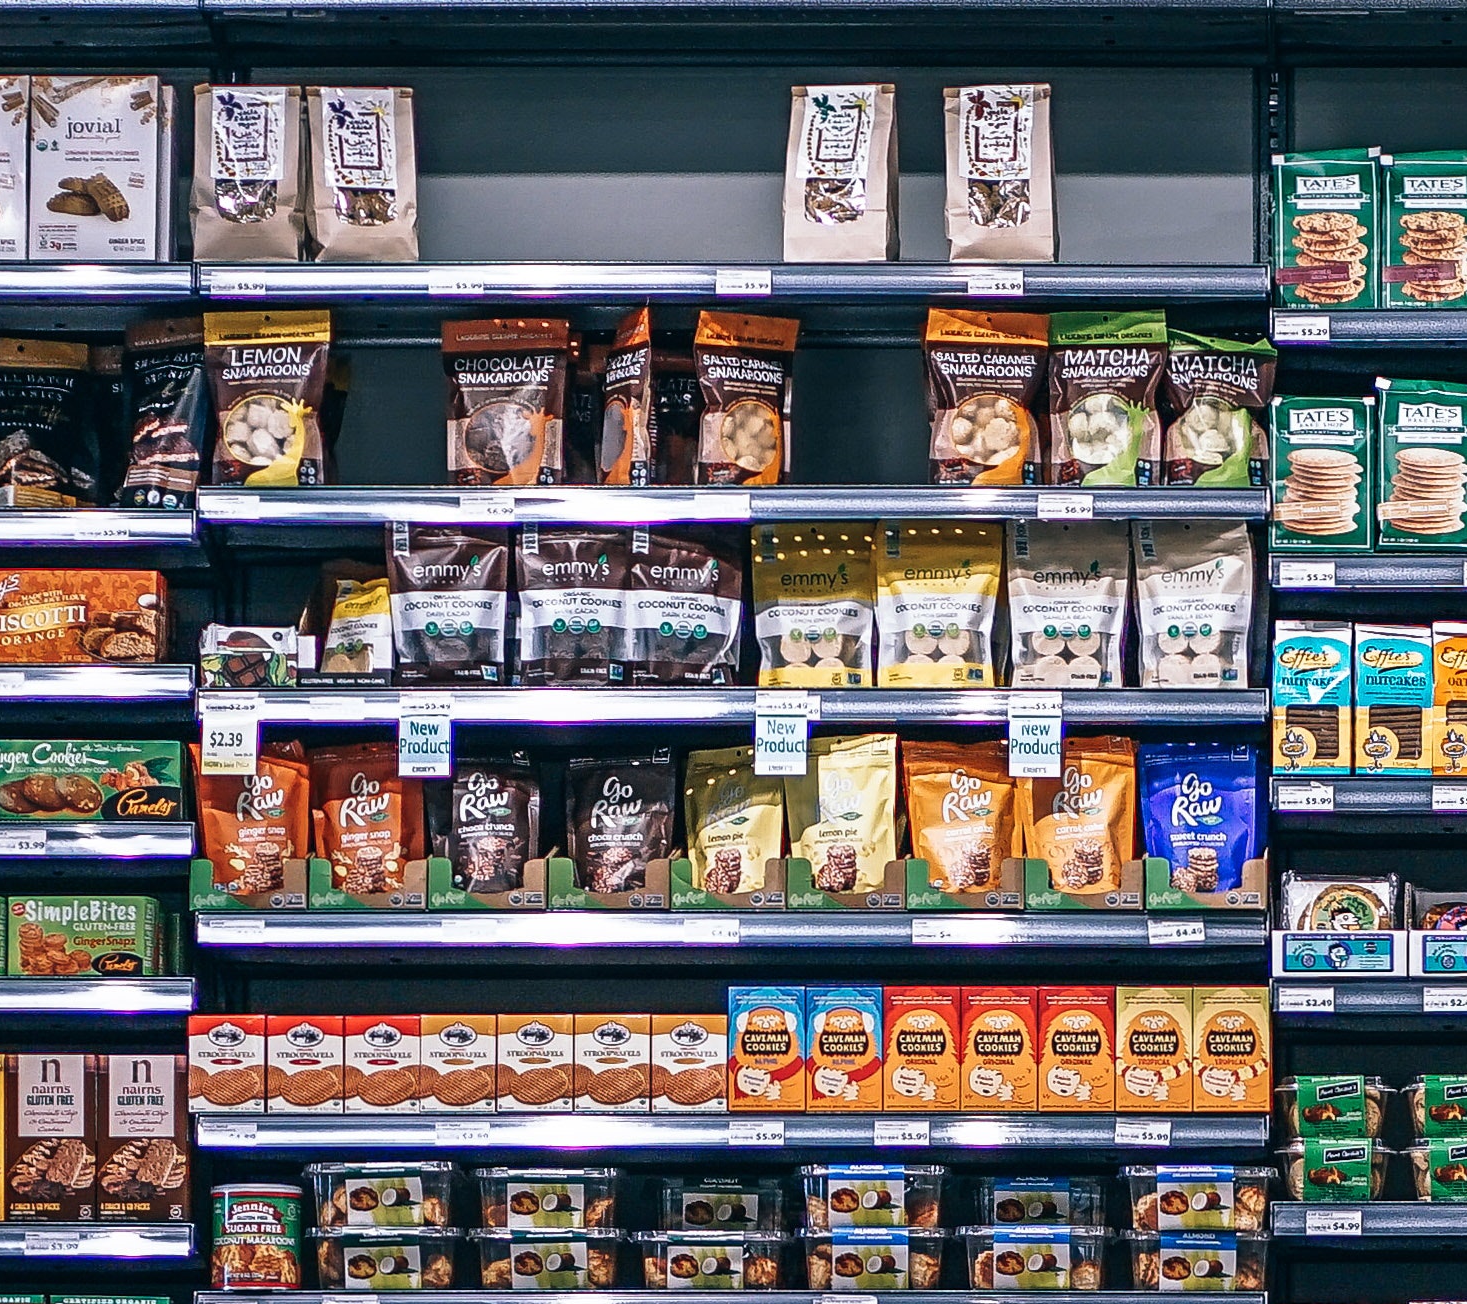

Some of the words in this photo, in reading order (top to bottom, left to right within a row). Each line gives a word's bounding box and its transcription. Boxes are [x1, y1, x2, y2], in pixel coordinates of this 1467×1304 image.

[1301, 327, 1328, 337] $5.29
[230, 347, 302, 366] LEMON
[454, 355, 555, 372] CHOCOLATE
[936, 351, 981, 365] SALTED
[983, 354, 1037, 365] CARAMEL
[1064, 349, 1150, 366] MATCHA
[222, 363, 311, 379] SNAKAROONS
[458, 369, 549, 384] SNAKAROONS
[940, 362, 1032, 378] SNAKAROONS
[1061, 365, 1148, 379] SNAKAROONS
[1064, 505, 1091, 515] $6.99
[413, 556, 482, 580] emmy's
[403, 600, 447, 611] COCONUT
[449, 600, 493, 611] COOKIES
[0, 628, 66, 645] ORANGE
[1361, 647, 1410, 668] Effie's
[409, 720, 440, 737] New
[210, 730, 243, 749] $2.39
[399, 737, 450, 757] Product
[42, 742, 109, 768] Cookies
[350, 773, 380, 798] Go
[1181, 773, 1213, 798] Go
[340, 791, 390, 827] Raw
[1171, 794, 1223, 828] Raw
[1170, 832, 1194, 841] sweet
[1196, 831, 1227, 841] crunch
[1305, 998, 1332, 1008] $2.49
[898, 1032, 945, 1045] CAVEMAN
[899, 1042, 942, 1055] COOKIES
[1332, 1221, 1360, 1231] $4.99
